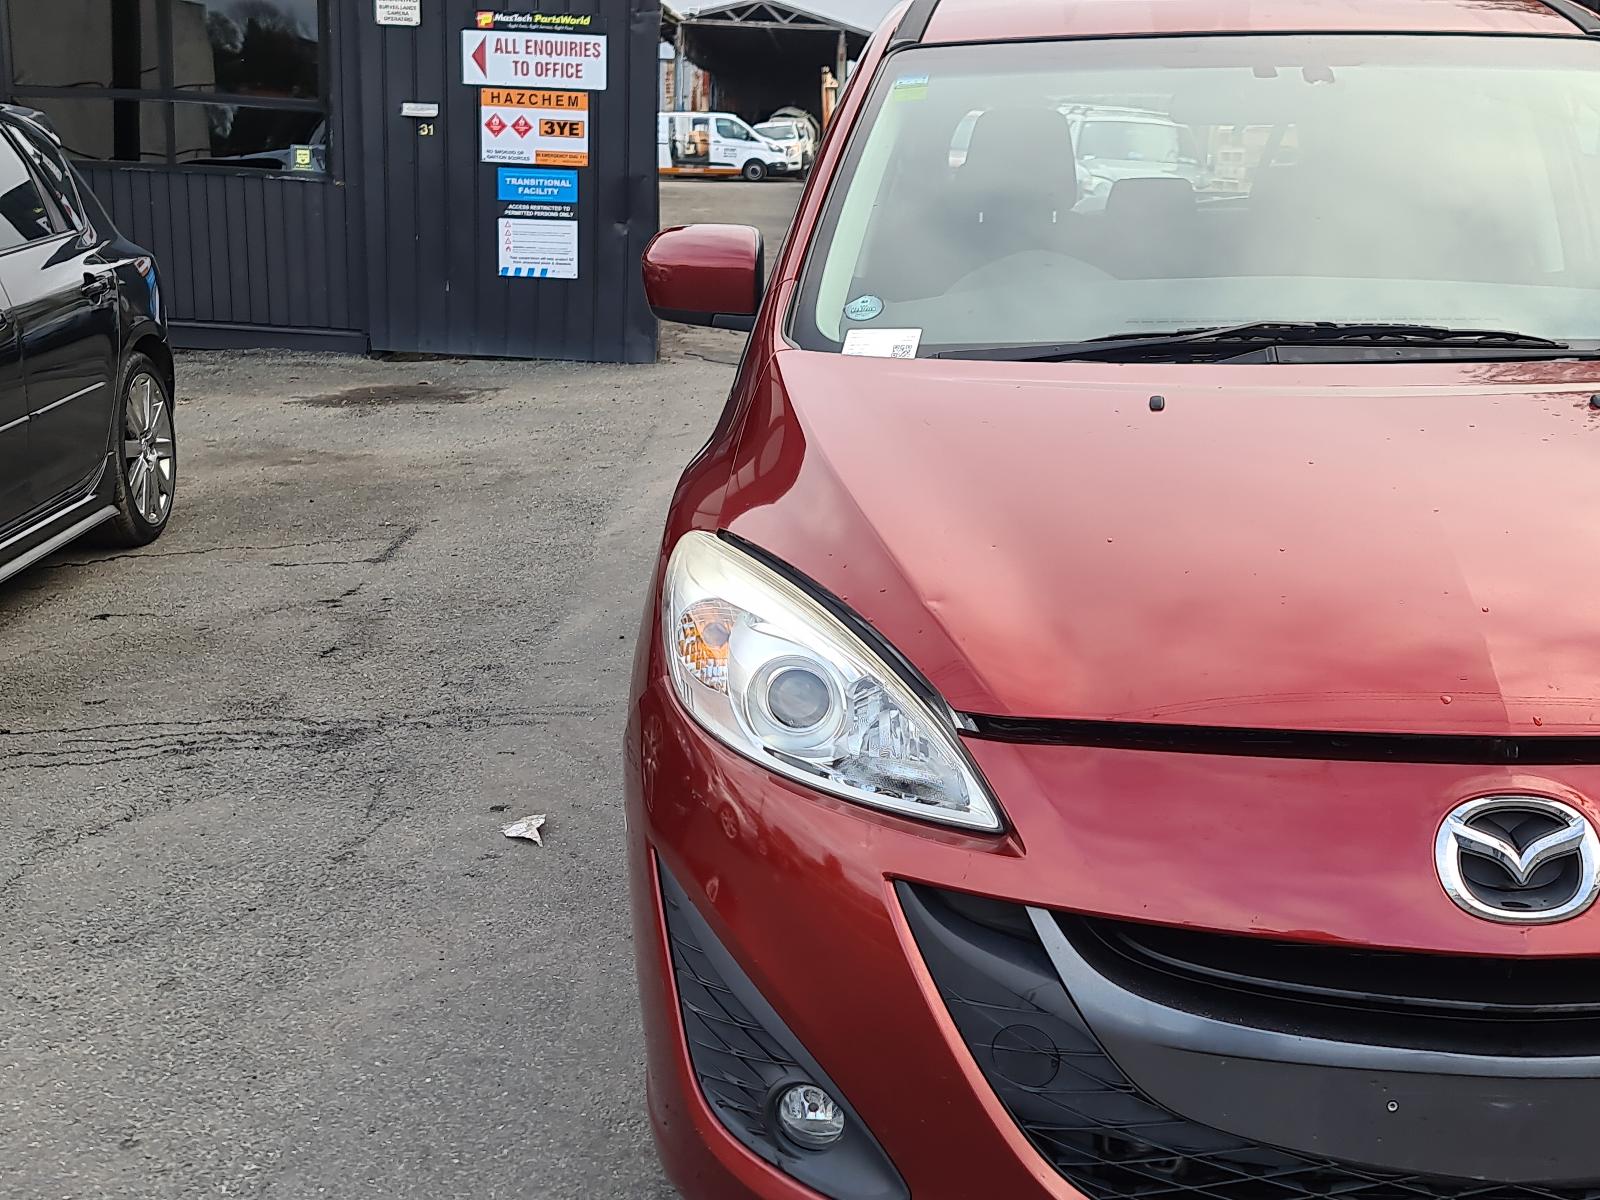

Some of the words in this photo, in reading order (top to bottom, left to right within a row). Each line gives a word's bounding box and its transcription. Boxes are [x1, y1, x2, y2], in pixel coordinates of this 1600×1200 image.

[534, 14, 591, 26] PartsWorld
[494, 37, 520, 54] ALL
[525, 39, 601, 58] ENQUIRIES
[512, 60, 530, 77] TO
[534, 61, 583, 79] OFFICE
[490, 91, 579, 107] HAZCHEM
[418, 123, 434, 136] 31
[544, 121, 580, 136] 3YE
[505, 177, 572, 187] TRANSITIONAL
[518, 187, 559, 195] FACILITY
